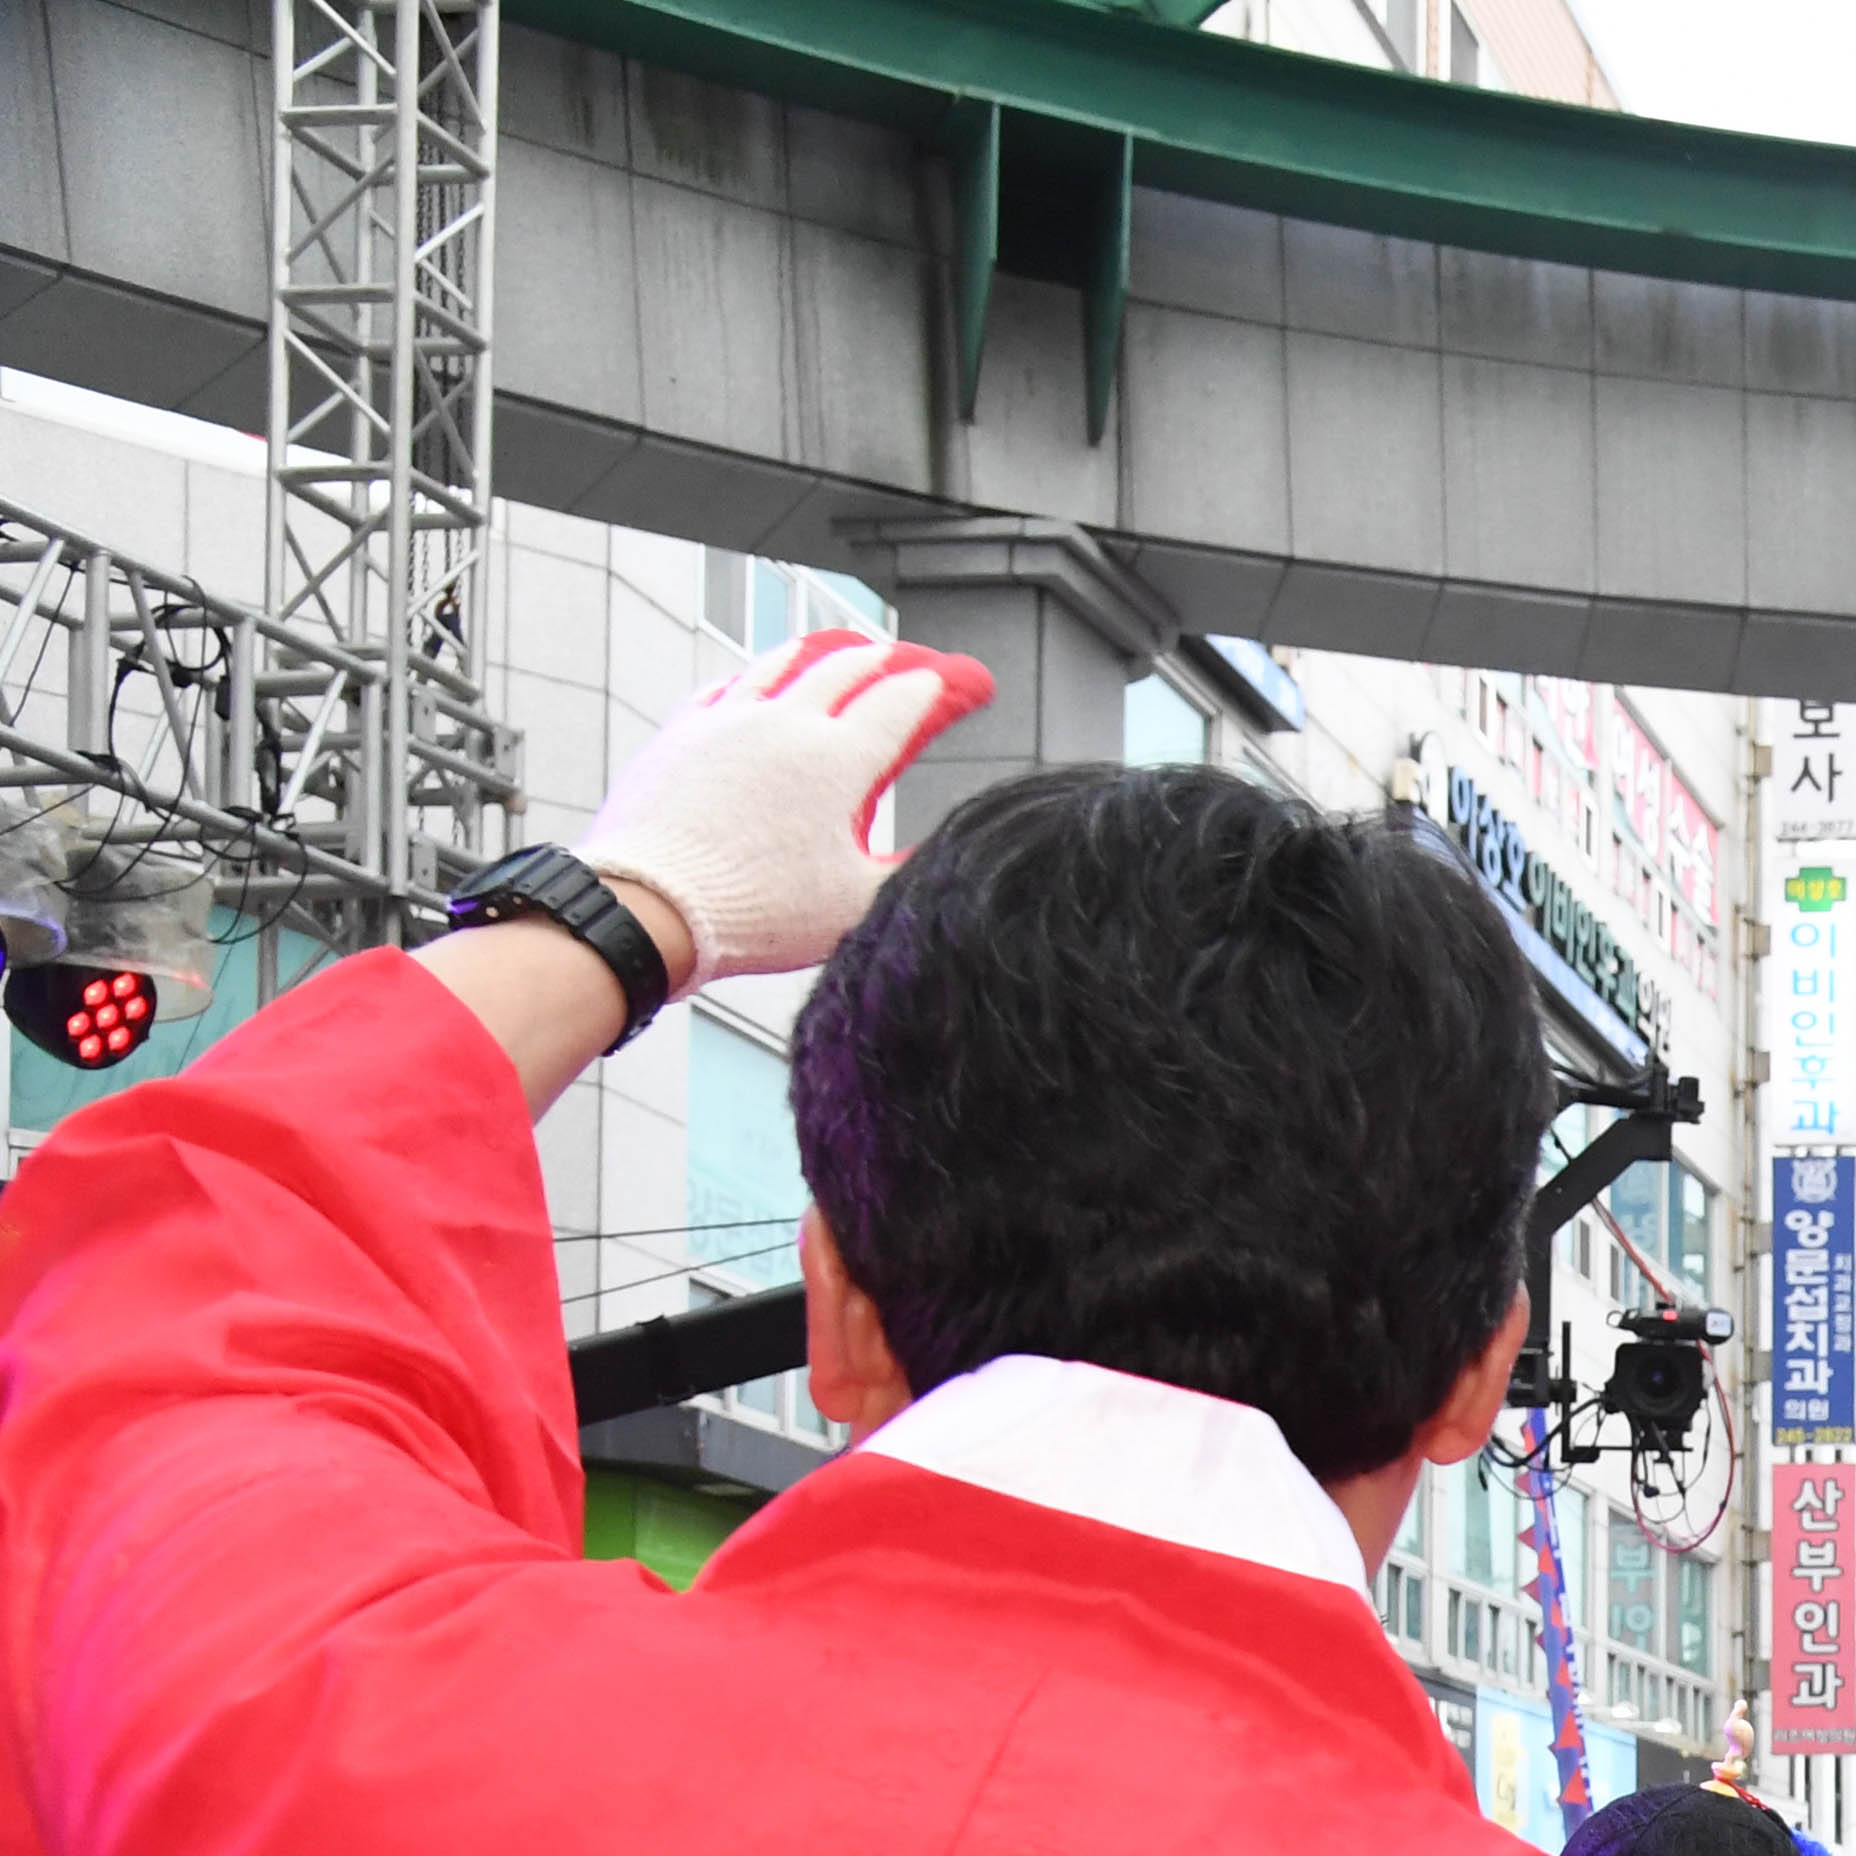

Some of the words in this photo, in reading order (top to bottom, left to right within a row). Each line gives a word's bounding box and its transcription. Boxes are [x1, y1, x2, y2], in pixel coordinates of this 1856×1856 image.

[1790, 922, 1839, 1135] 이비인후과
[1784, 1208, 1835, 1395] 양문섭치과
[1784, 1398, 1829, 1421] 의원
[1791, 1478, 1844, 1711] 산부인과
